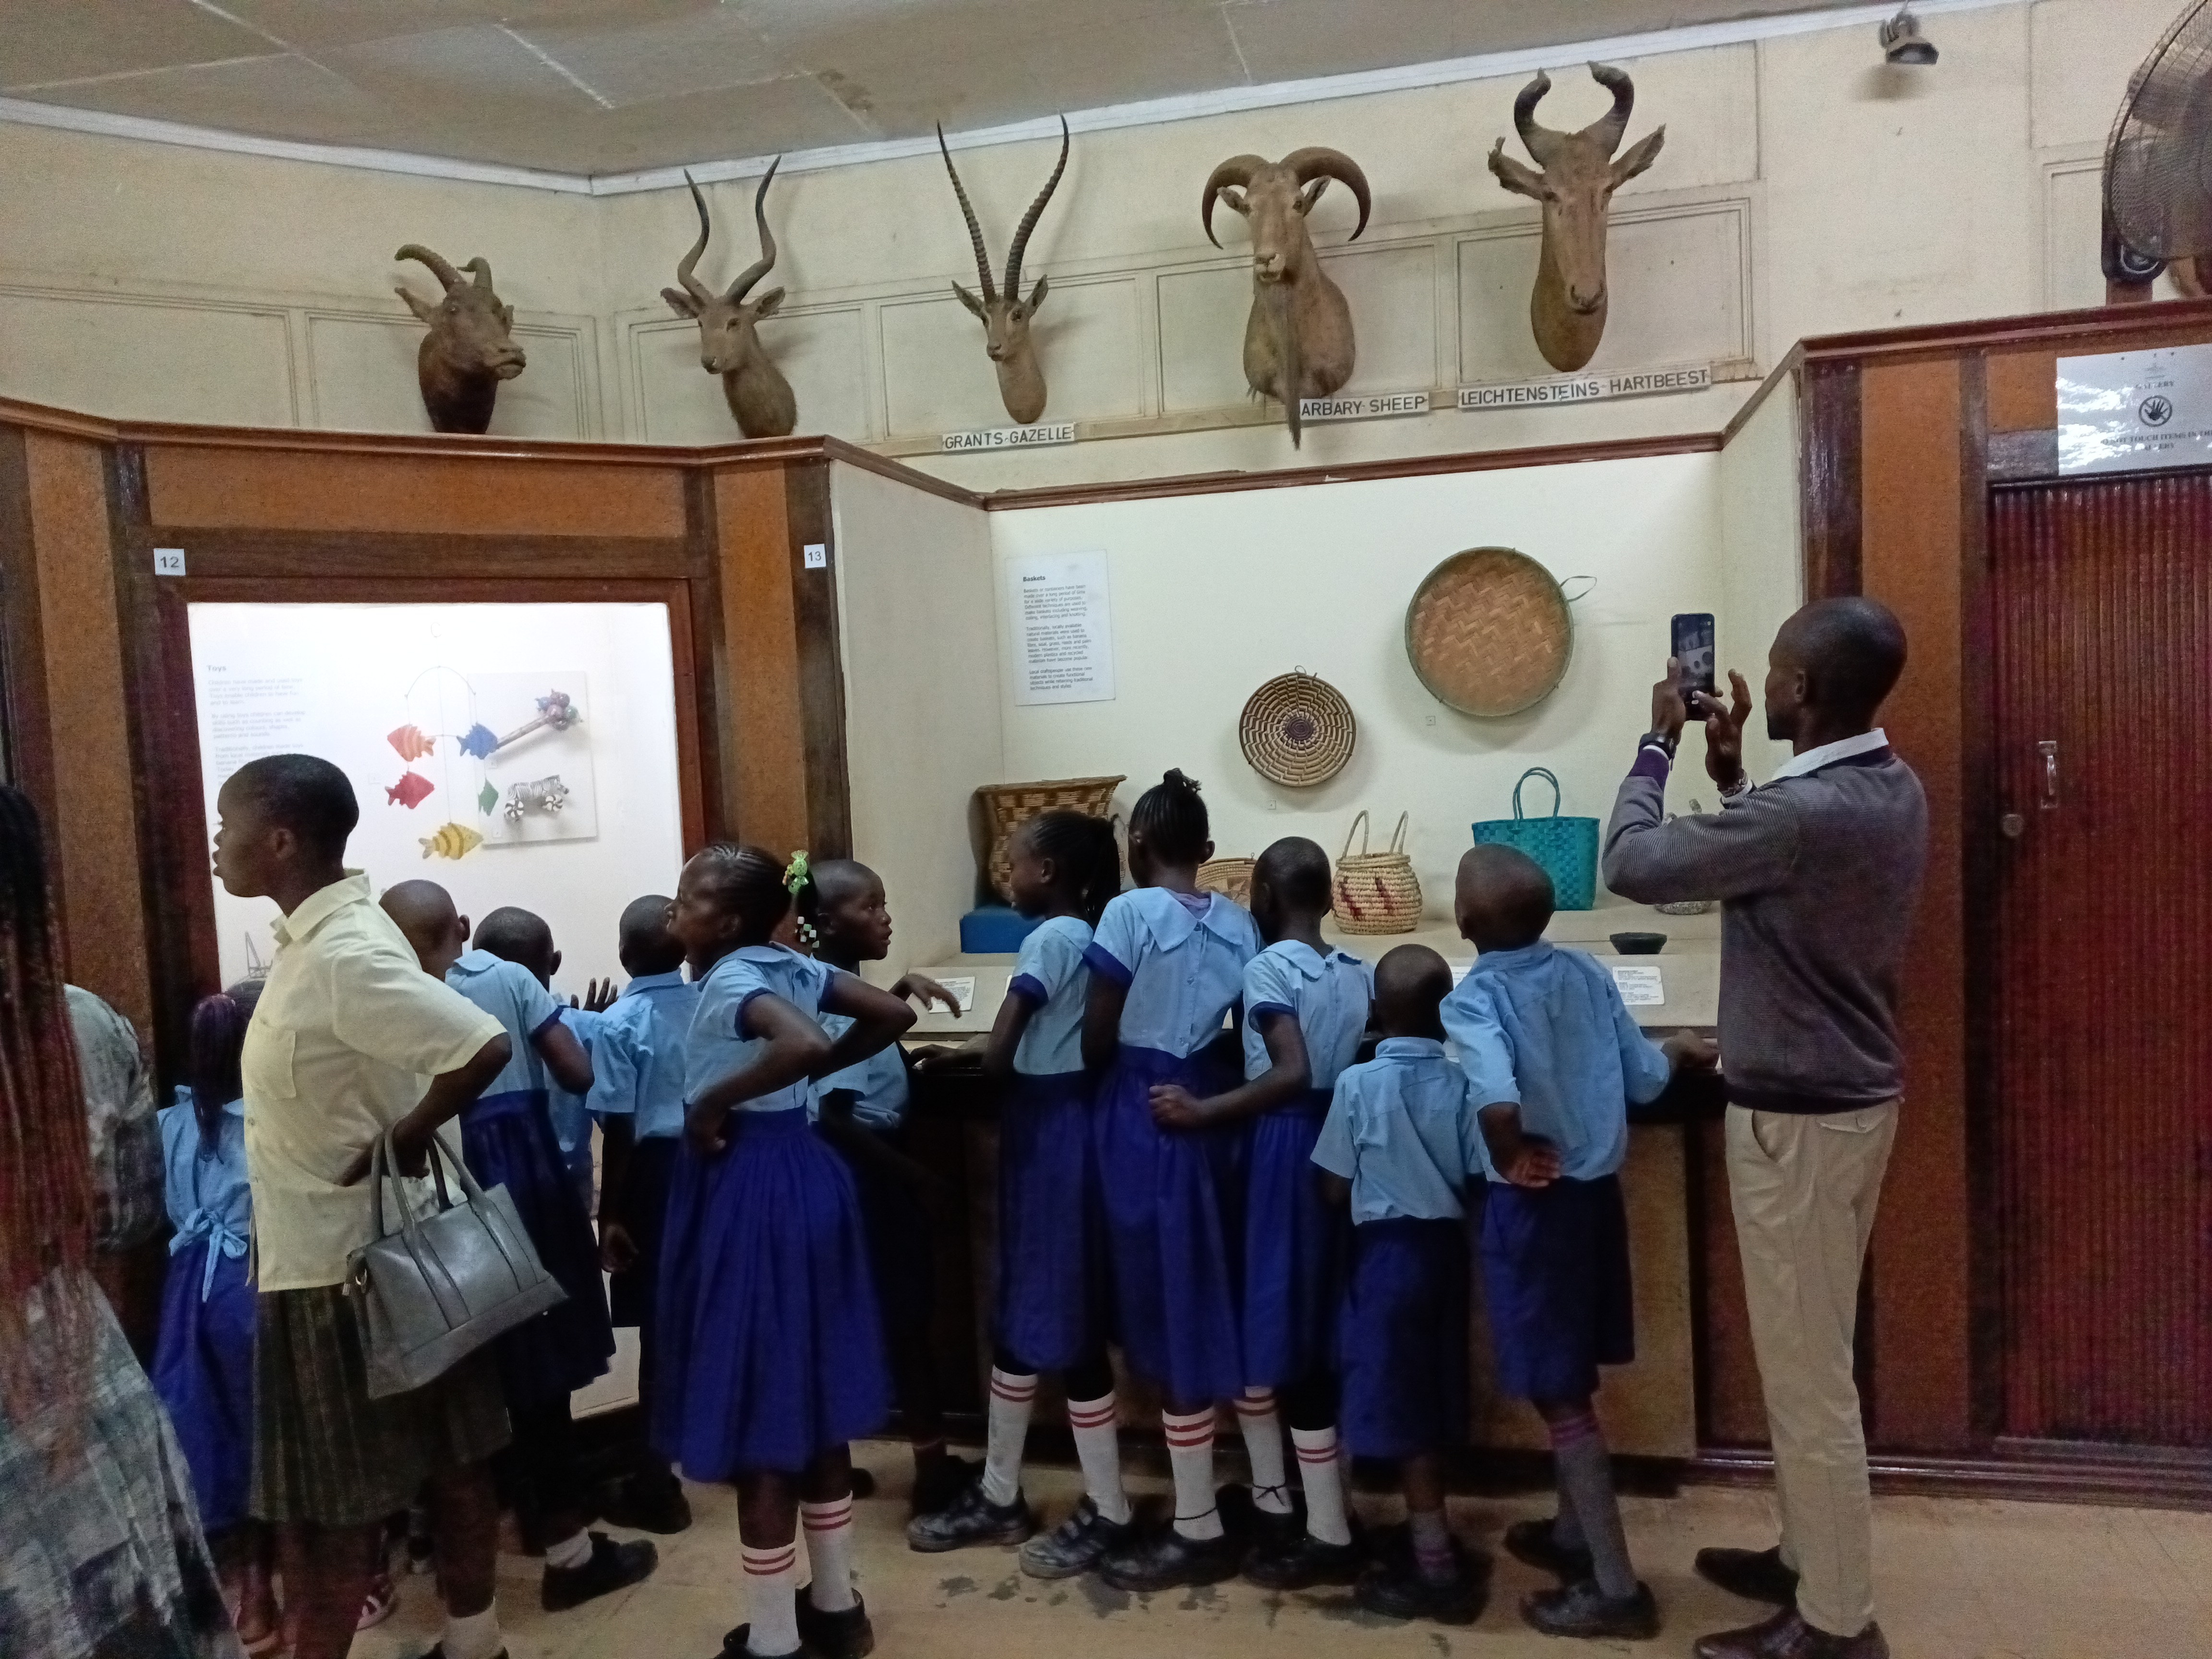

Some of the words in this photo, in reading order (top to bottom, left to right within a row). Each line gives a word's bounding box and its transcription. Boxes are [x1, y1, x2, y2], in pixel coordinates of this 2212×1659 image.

[1461, 382, 1599, 406] LEICHTENSTEINS
[1610, 369, 1707, 393] HARTBEEST
[1301, 401, 1362, 416] ARBARY
[1370, 396, 1425, 412] SHEEP
[945, 432, 1003, 449] GRANTS
[1010, 426, 1071, 444] GAZELLE
[160, 556, 180, 568] 12
[808, 551, 821, 562] 13
